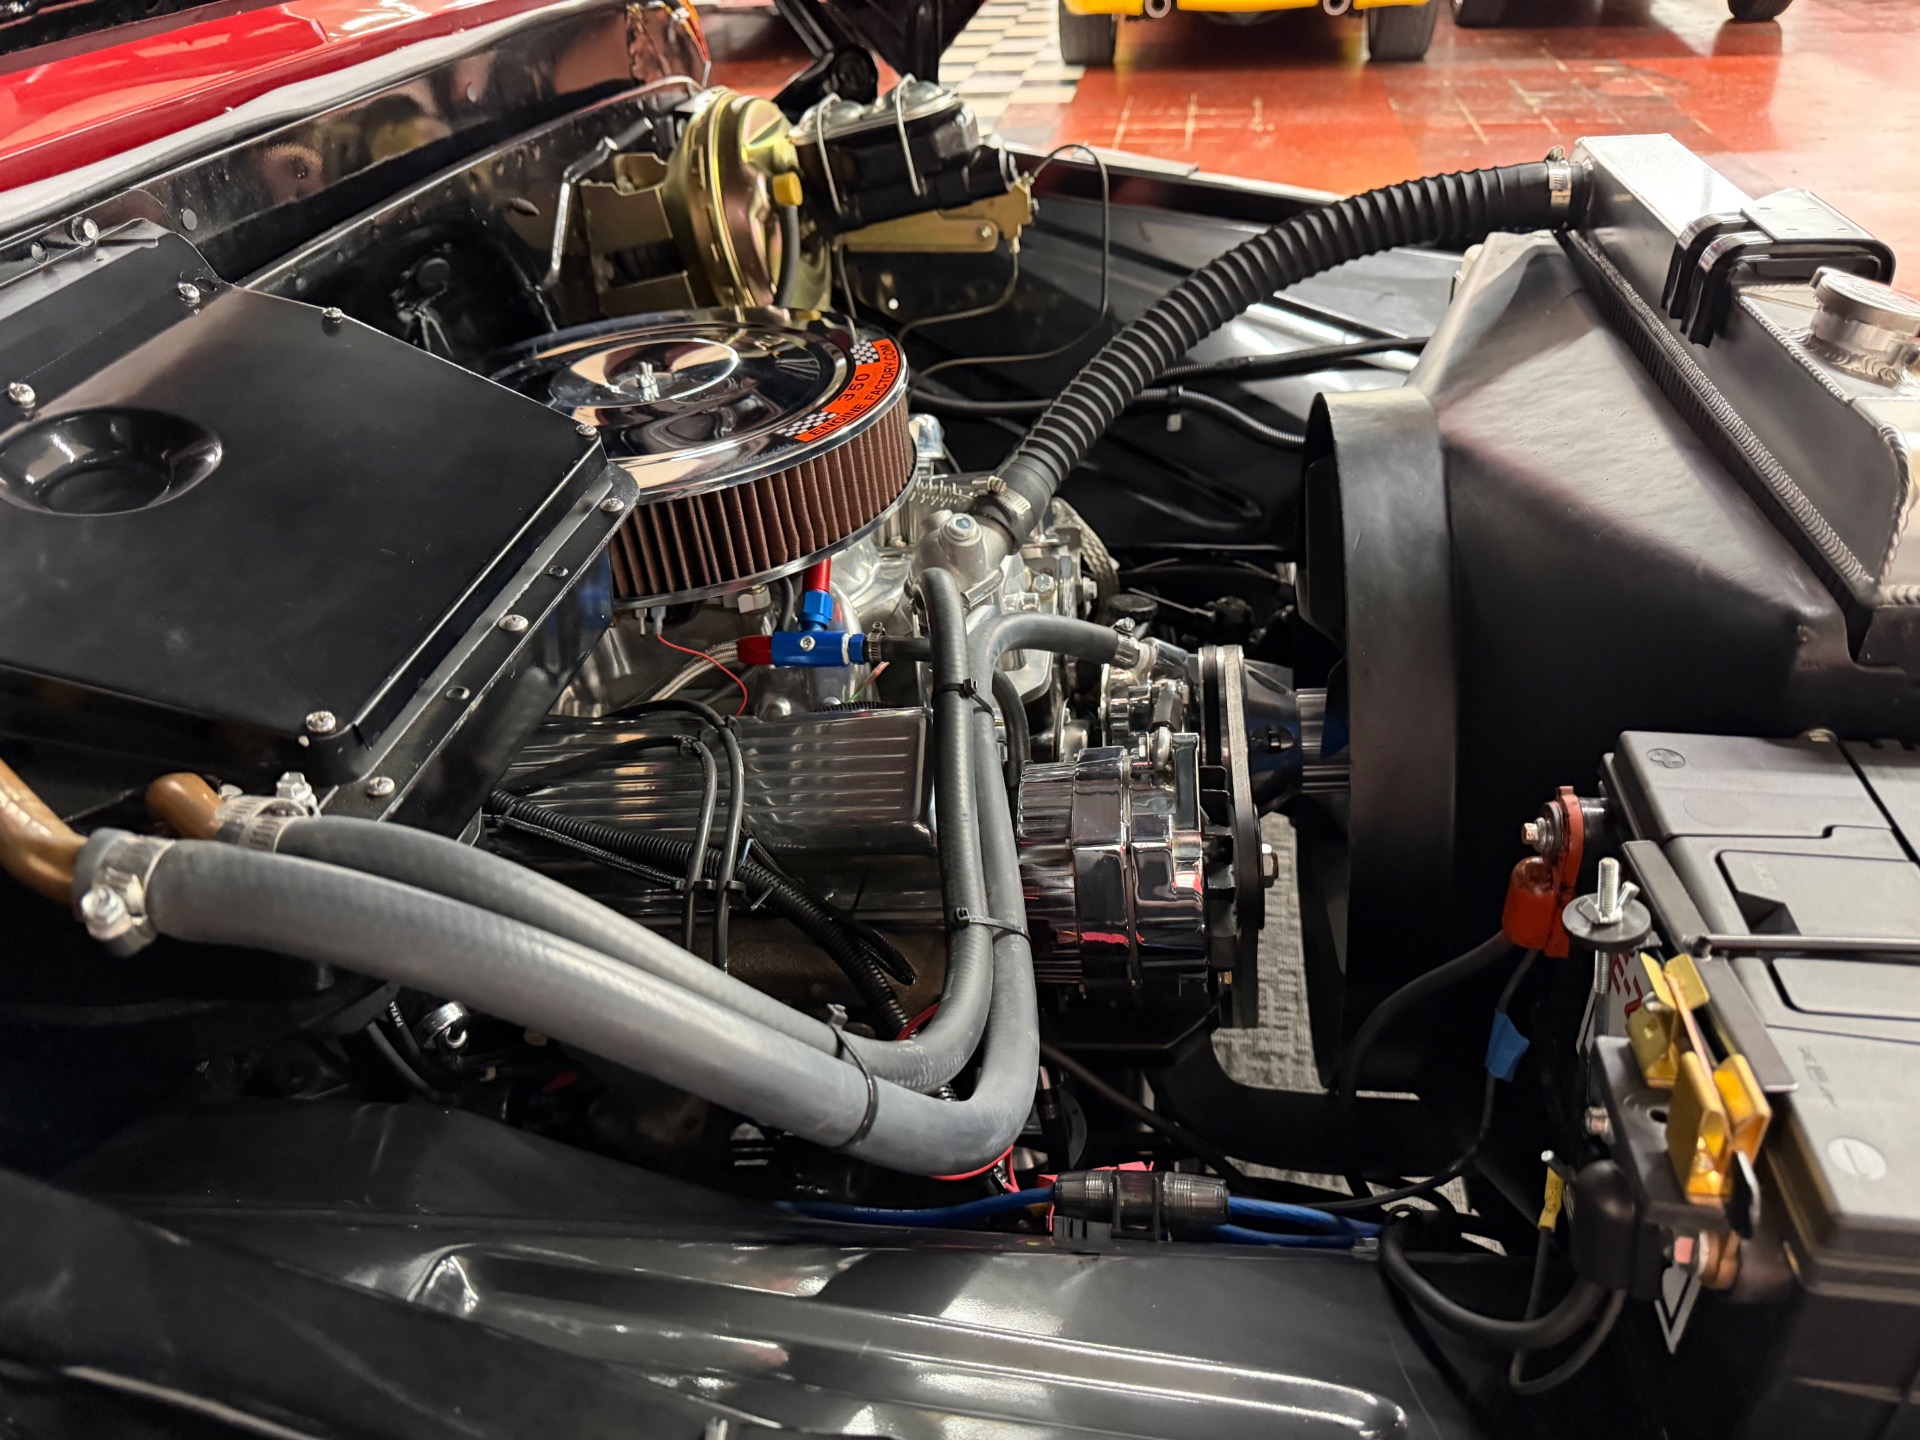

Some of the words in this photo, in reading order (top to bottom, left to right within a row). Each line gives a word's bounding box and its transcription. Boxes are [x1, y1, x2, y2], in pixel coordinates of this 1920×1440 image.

[811, 404, 868, 436] ENGINE
[864, 344, 898, 401] FACTORY.COM
[838, 373, 870, 402] 350
